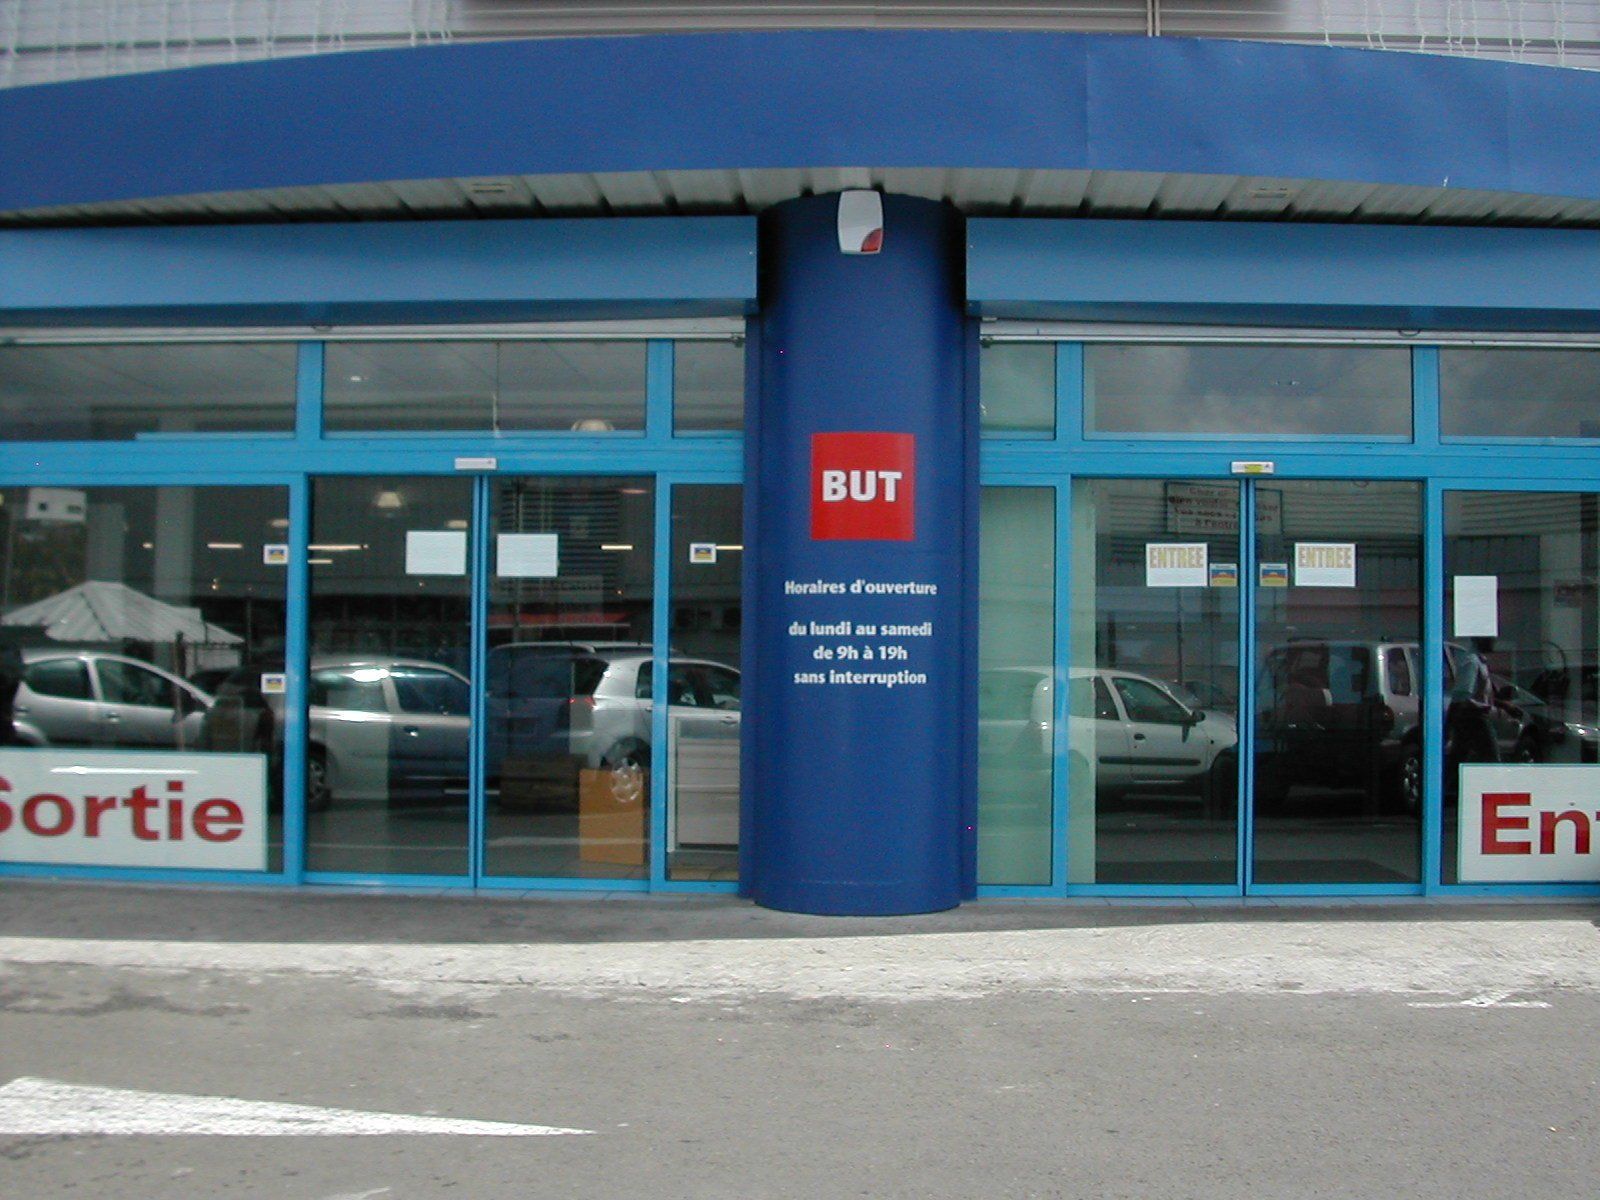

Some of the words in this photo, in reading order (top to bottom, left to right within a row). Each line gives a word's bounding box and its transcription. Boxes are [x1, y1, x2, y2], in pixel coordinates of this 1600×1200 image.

[822, 469, 903, 502] BUT
[784, 579, 847, 595] Horaires
[850, 579, 938, 595] d'ouverture
[788, 621, 807, 636] du
[810, 621, 852, 636] lundi
[855, 624, 877, 636] au
[880, 622, 932, 636] samedi
[813, 645, 834, 660] de
[836, 645, 859, 660] 9h
[862, 645, 874, 660] à
[878, 645, 908, 660] 19h
[793, 672, 826, 684] sans
[829, 669, 927, 688] interruption
[0, 775, 244, 843] ortie
[1481, 792, 1600, 855] En
